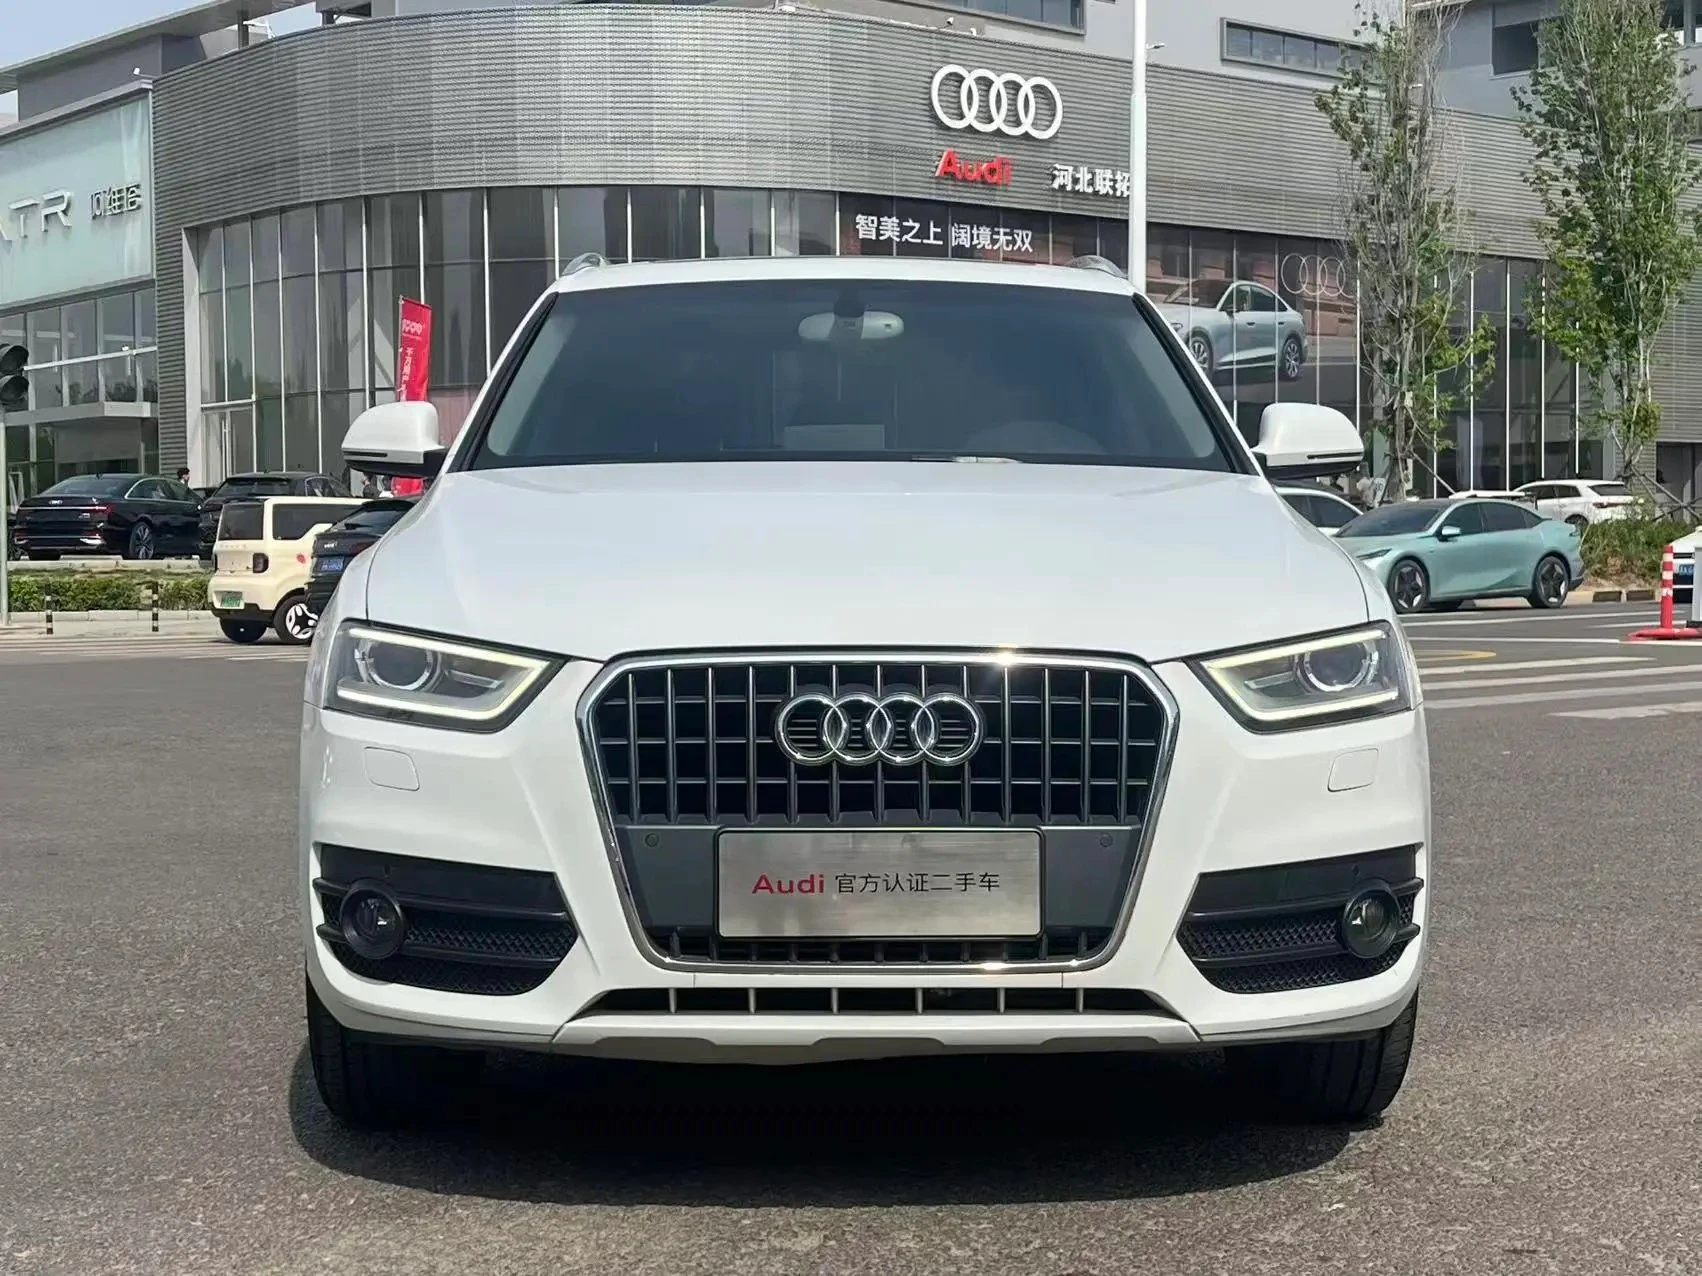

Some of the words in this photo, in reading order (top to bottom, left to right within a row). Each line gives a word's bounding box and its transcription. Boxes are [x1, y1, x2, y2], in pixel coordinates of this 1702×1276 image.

[935, 148, 1013, 186] Audi
[855, 213, 943, 245] 智美之上
[951, 222, 1033, 253] 阔境无双
[752, 871, 825, 895] Audi
[834, 871, 1000, 894] 官方认证二手车
